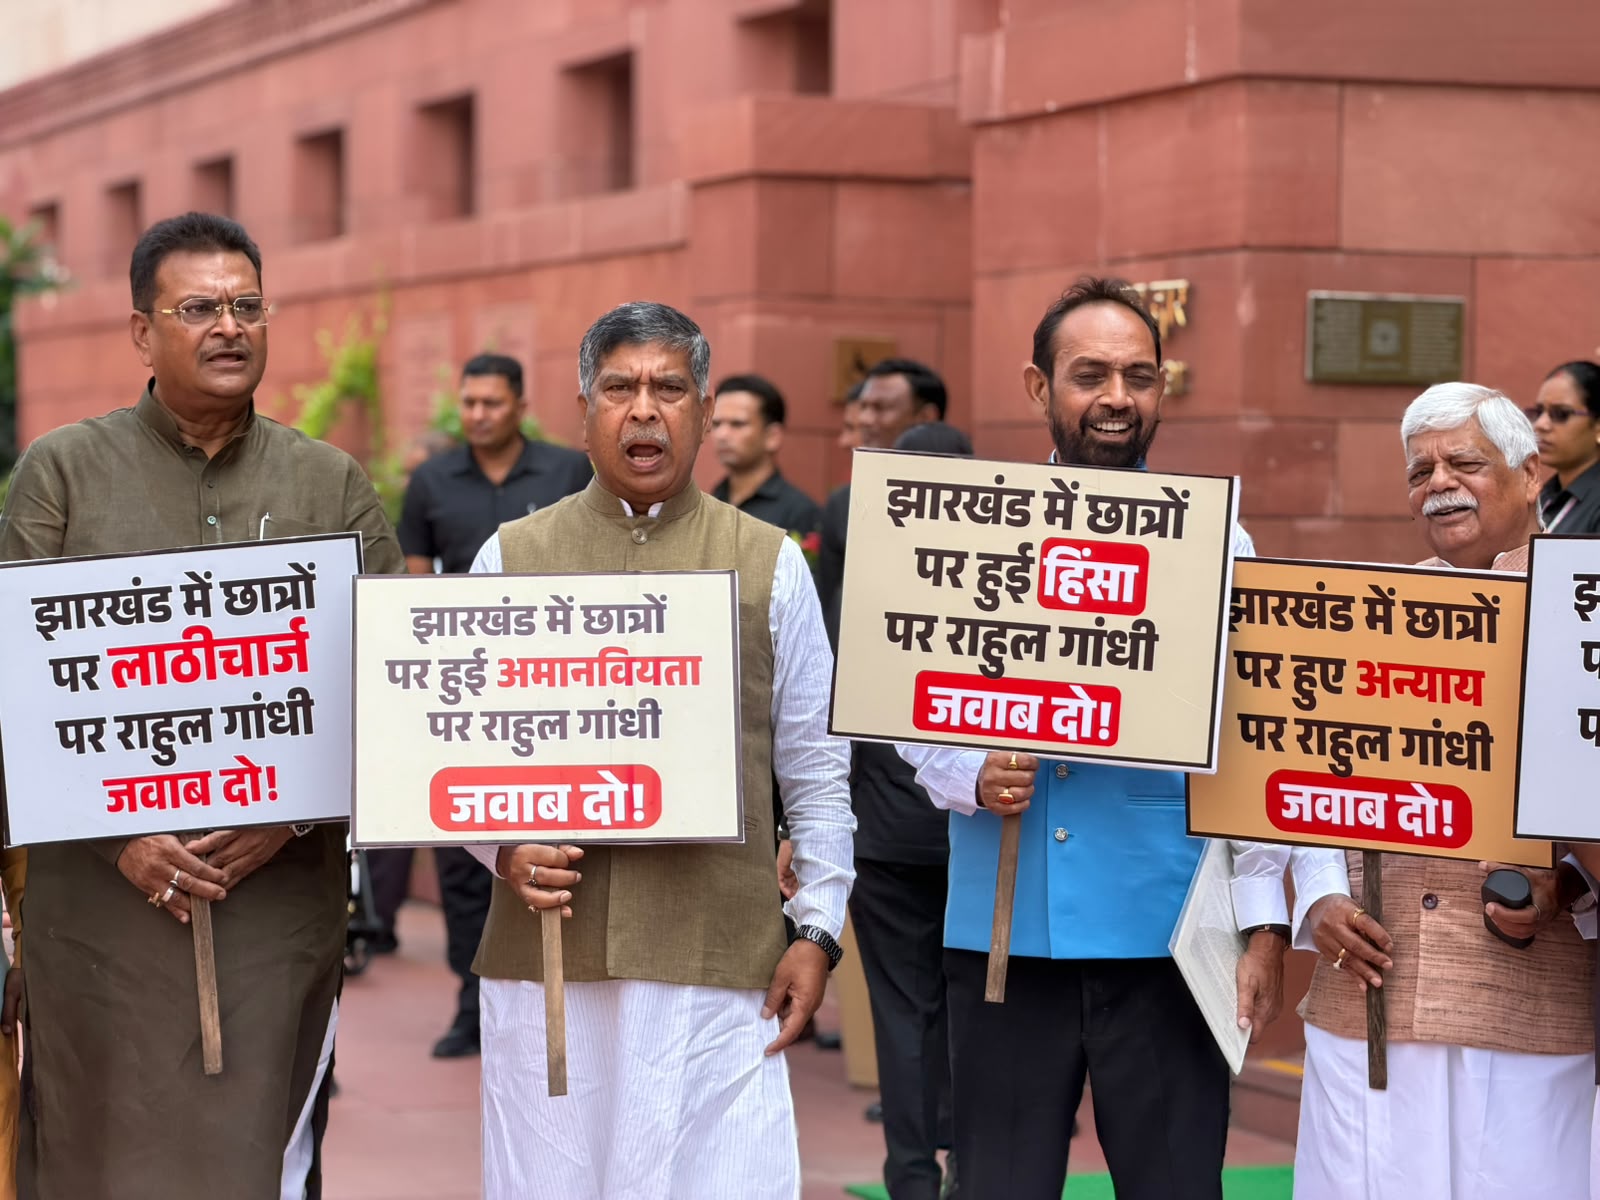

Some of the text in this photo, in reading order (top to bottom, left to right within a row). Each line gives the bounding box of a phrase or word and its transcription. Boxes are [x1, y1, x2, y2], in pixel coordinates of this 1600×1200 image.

[886, 474, 1191, 540] झारखंड में छात्रों
[31, 562, 317, 641] झारखंड में छात्रों
[914, 541, 1139, 612] पर हुई हिंसा
[410, 593, 668, 645] झारखंड में छात्रों
[1363, 584, 1396, 635] में
[1402, 592, 1501, 644] छात्रों
[49, 616, 310, 692] पर लाठीचार्ज
[385, 646, 702, 705] पर हुई अमानवियता
[884, 612, 1159, 679] पर राहुल गांधी
[1233, 650, 1486, 711] पर हुए अन्याय
[55, 687, 314, 766] पर राहुल गांधी
[426, 697, 662, 757] पर राहुल गांधी
[926, 685, 1113, 742] जवाब दो!
[1237, 713, 1494, 778] पर राहुल गांधी
[102, 755, 278, 813] जवाब दो!
[447, 770, 645, 825] जवाब दो!
[1278, 782, 1454, 838] जवाब दो!
